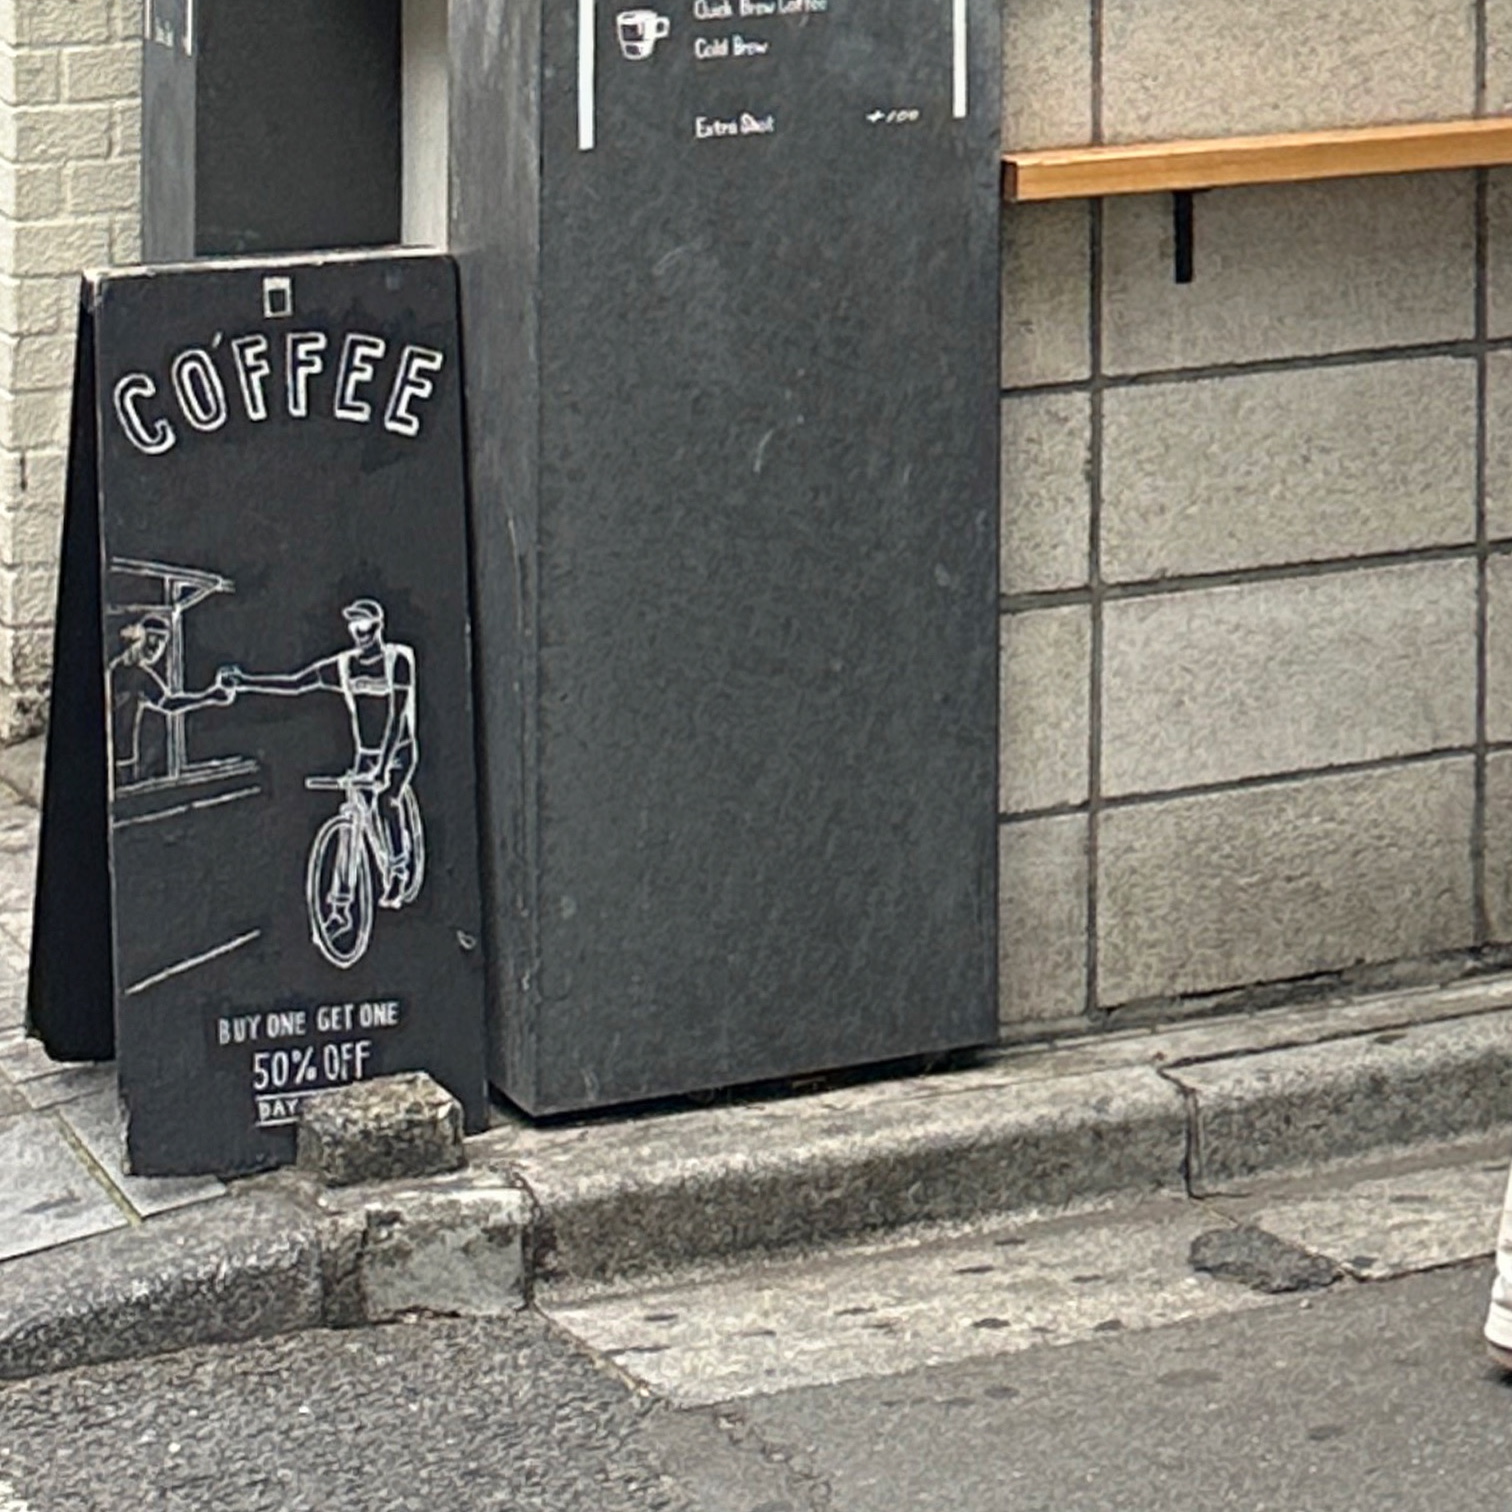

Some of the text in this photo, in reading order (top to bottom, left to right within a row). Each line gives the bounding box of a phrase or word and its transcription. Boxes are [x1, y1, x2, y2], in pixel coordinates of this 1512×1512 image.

[695, 35, 768, 59] Cold Brew
[695, 115, 738, 138] Extra
[218, 1000, 399, 1045] BUY ONE GET ONE
[253, 1040, 372, 1089] 50% OFF
